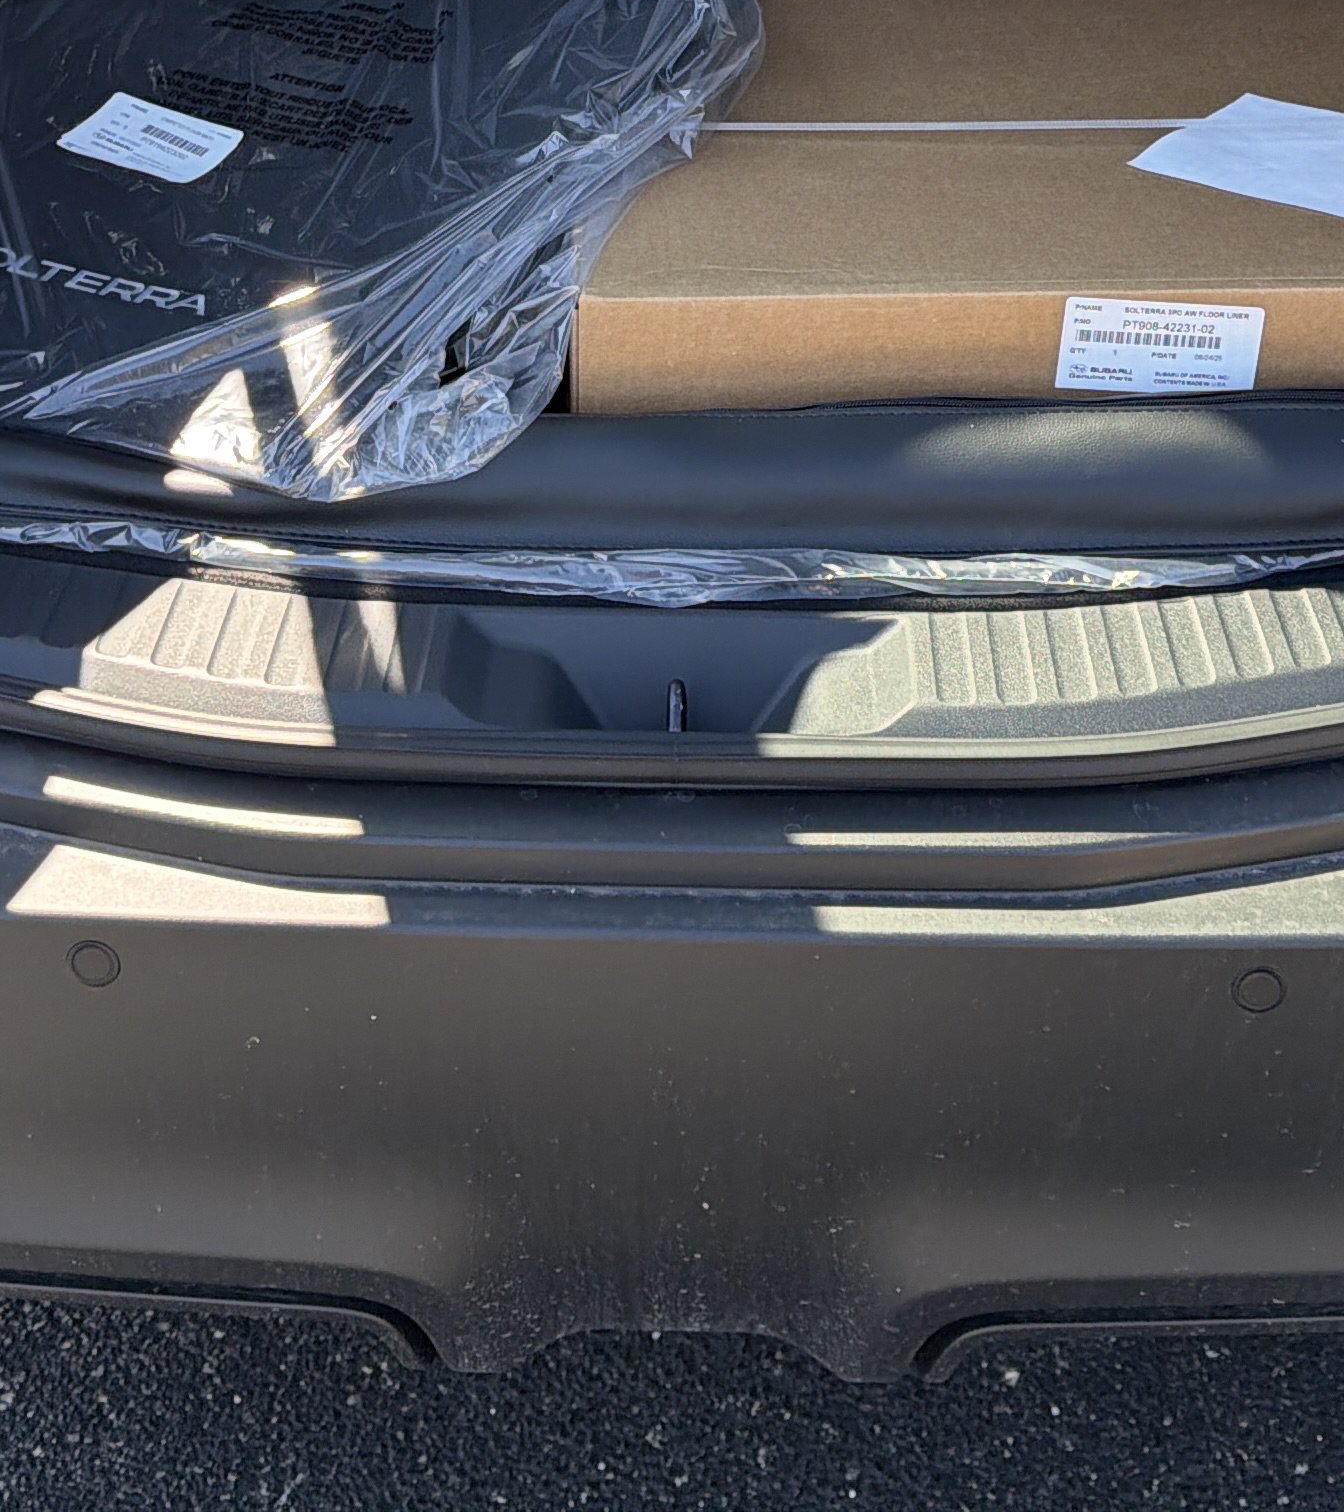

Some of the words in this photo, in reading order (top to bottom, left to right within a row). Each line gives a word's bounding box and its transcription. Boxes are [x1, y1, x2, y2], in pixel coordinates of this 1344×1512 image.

[1124, 307, 1166, 315] SOLTERRA
[1226, 312, 1250, 320] LINER
[1122, 320, 1216, 334] PT908-42231-02
